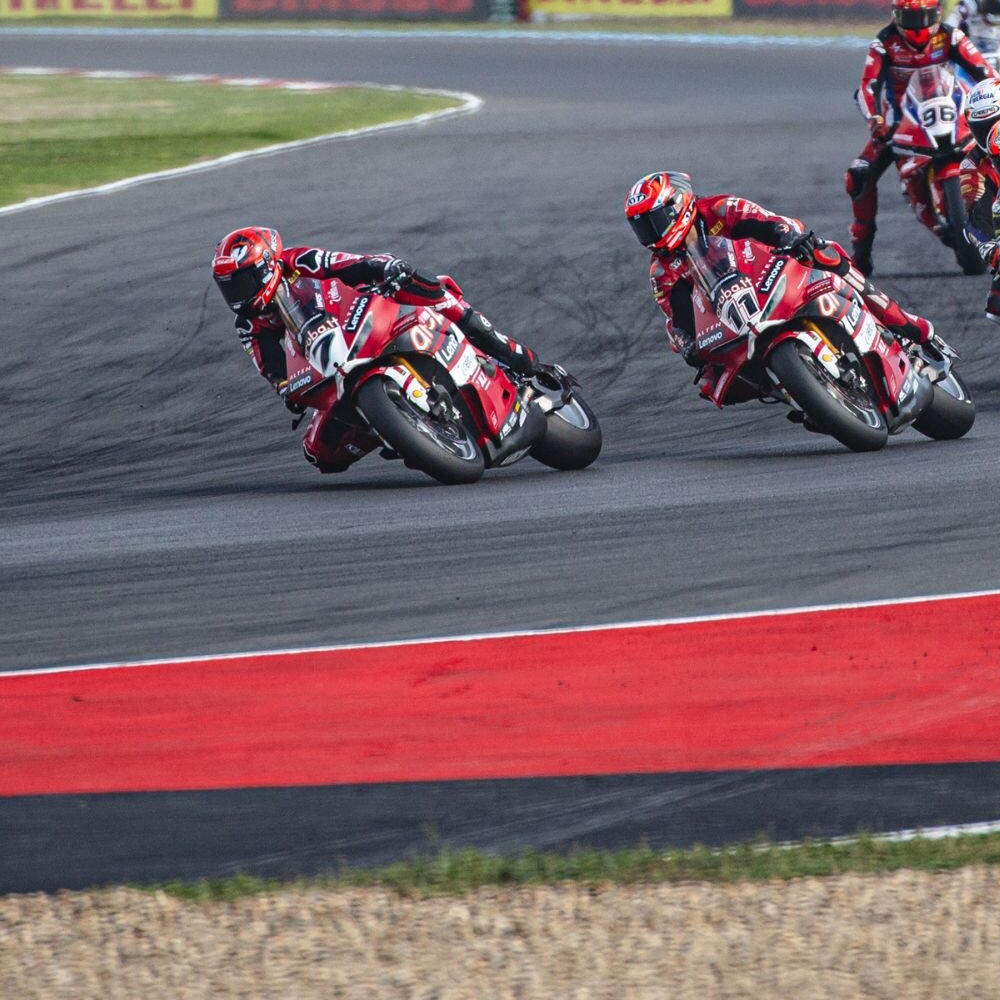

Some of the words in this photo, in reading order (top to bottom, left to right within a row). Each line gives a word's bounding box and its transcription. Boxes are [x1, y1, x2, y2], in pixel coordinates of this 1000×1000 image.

[922, 104, 956, 128] 96
[761, 260, 784, 292] Lenovo
[347, 297, 369, 331] Lenovo
[727, 289, 761, 333] 11
[696, 322, 722, 339] ALTEN
[698, 331, 723, 350] Lenovo
[311, 330, 337, 371] 7
[289, 375, 312, 393] Lenovo
